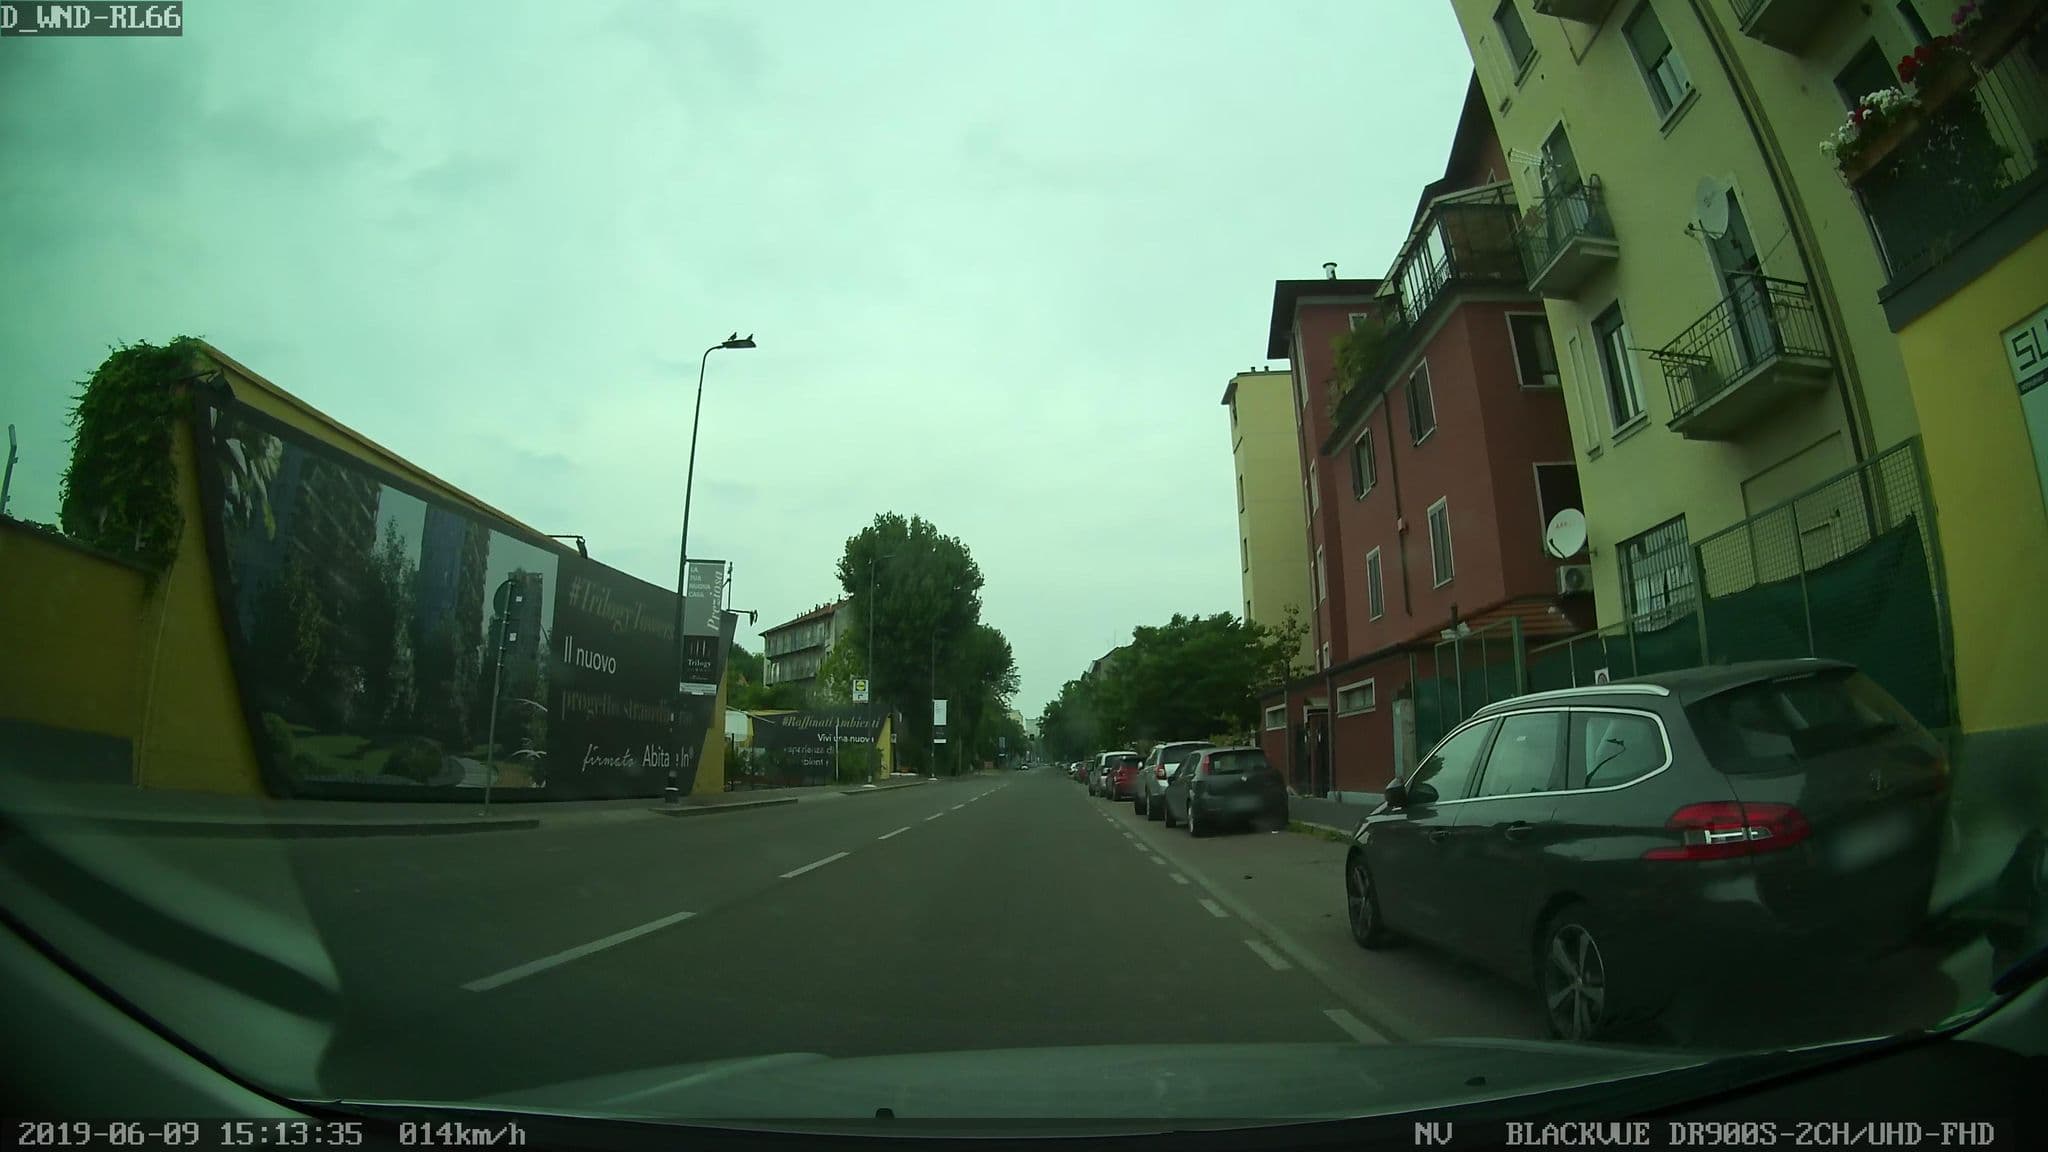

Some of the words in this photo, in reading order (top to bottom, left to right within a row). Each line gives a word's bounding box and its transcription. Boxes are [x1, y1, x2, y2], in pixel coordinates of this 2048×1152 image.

[564, 635, 573, 664] Il
[576, 645, 617, 675] nuovo
[687, 659, 711, 669] Trilogy
[817, 732, 832, 743] Vivi
[642, 744, 680, 768] Abita
